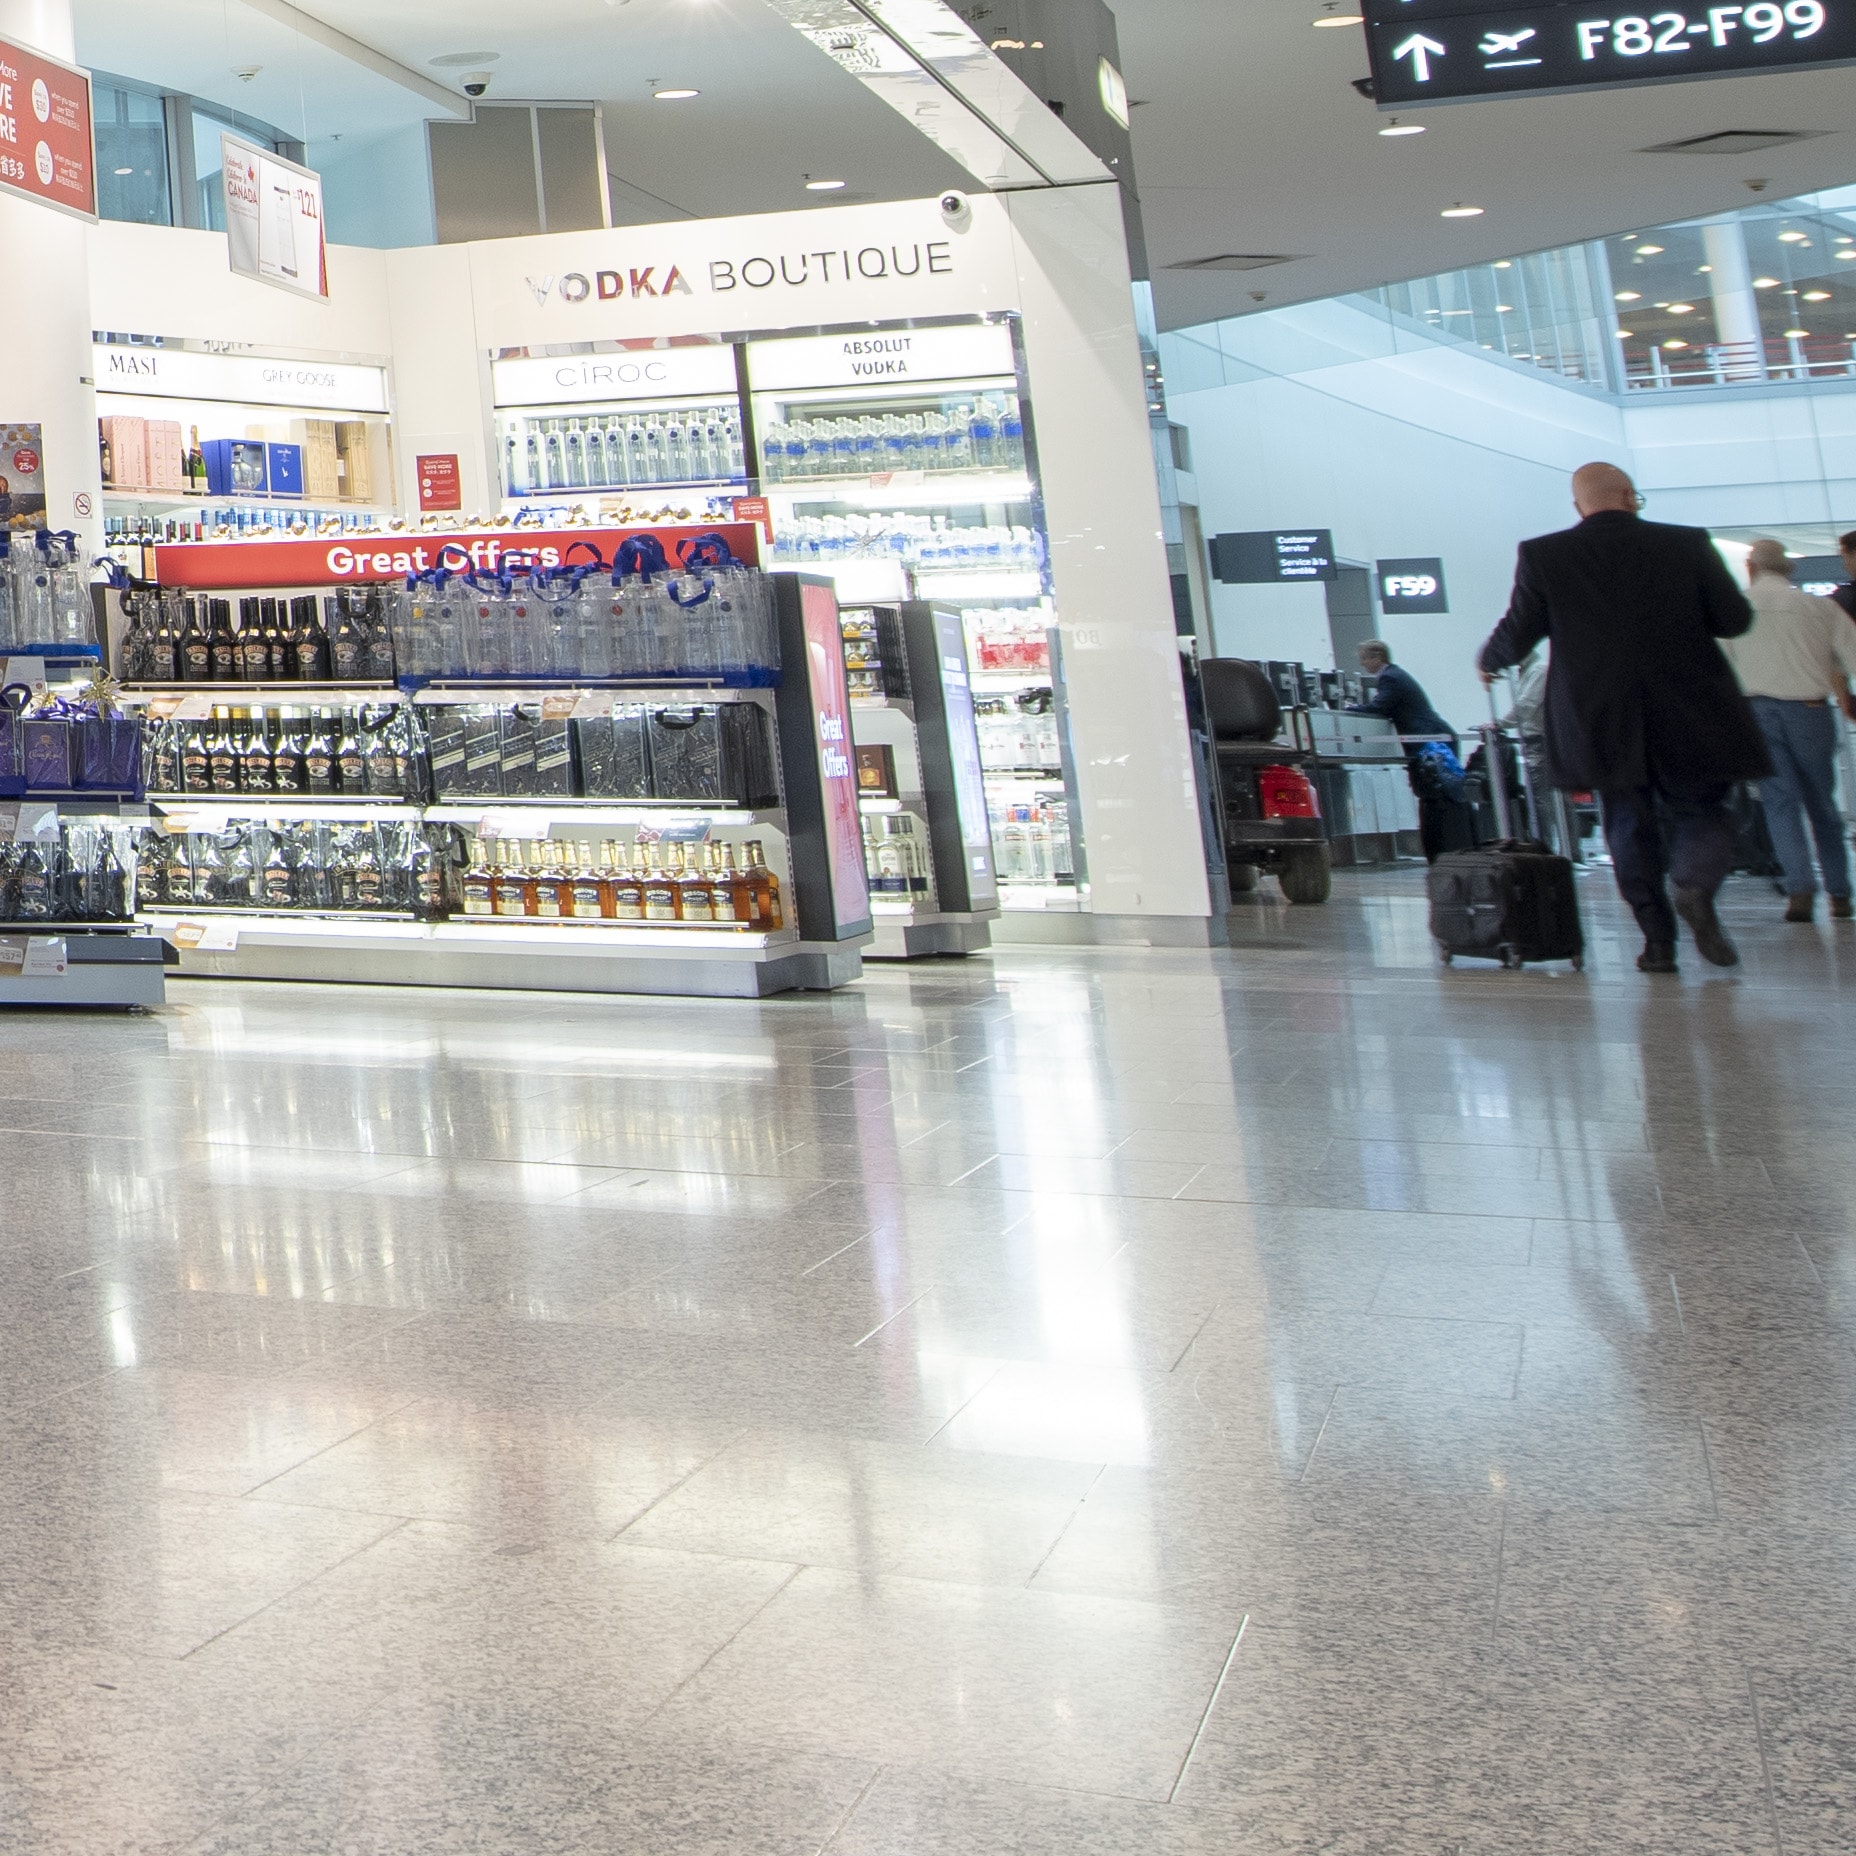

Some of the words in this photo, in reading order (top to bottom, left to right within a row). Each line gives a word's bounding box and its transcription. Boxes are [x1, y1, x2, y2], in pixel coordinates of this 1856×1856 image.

[228, 180, 258, 206] CANADA
[524, 263, 693, 307] VODKA
[709, 242, 952, 292] BOUTIQUE
[843, 338, 911, 355] ABSOLUT
[109, 354, 157, 376] MASI
[263, 369, 292, 383] GREY
[296, 371, 336, 387] GOOSE
[555, 361, 668, 387] CÎROC
[851, 359, 908, 375] VODKA
[327, 546, 429, 575] Great
[442, 542, 560, 572] Offers
[1385, 576, 1437, 597] F59
[819, 710, 844, 741] Great
[822, 748, 850, 779] Offers
